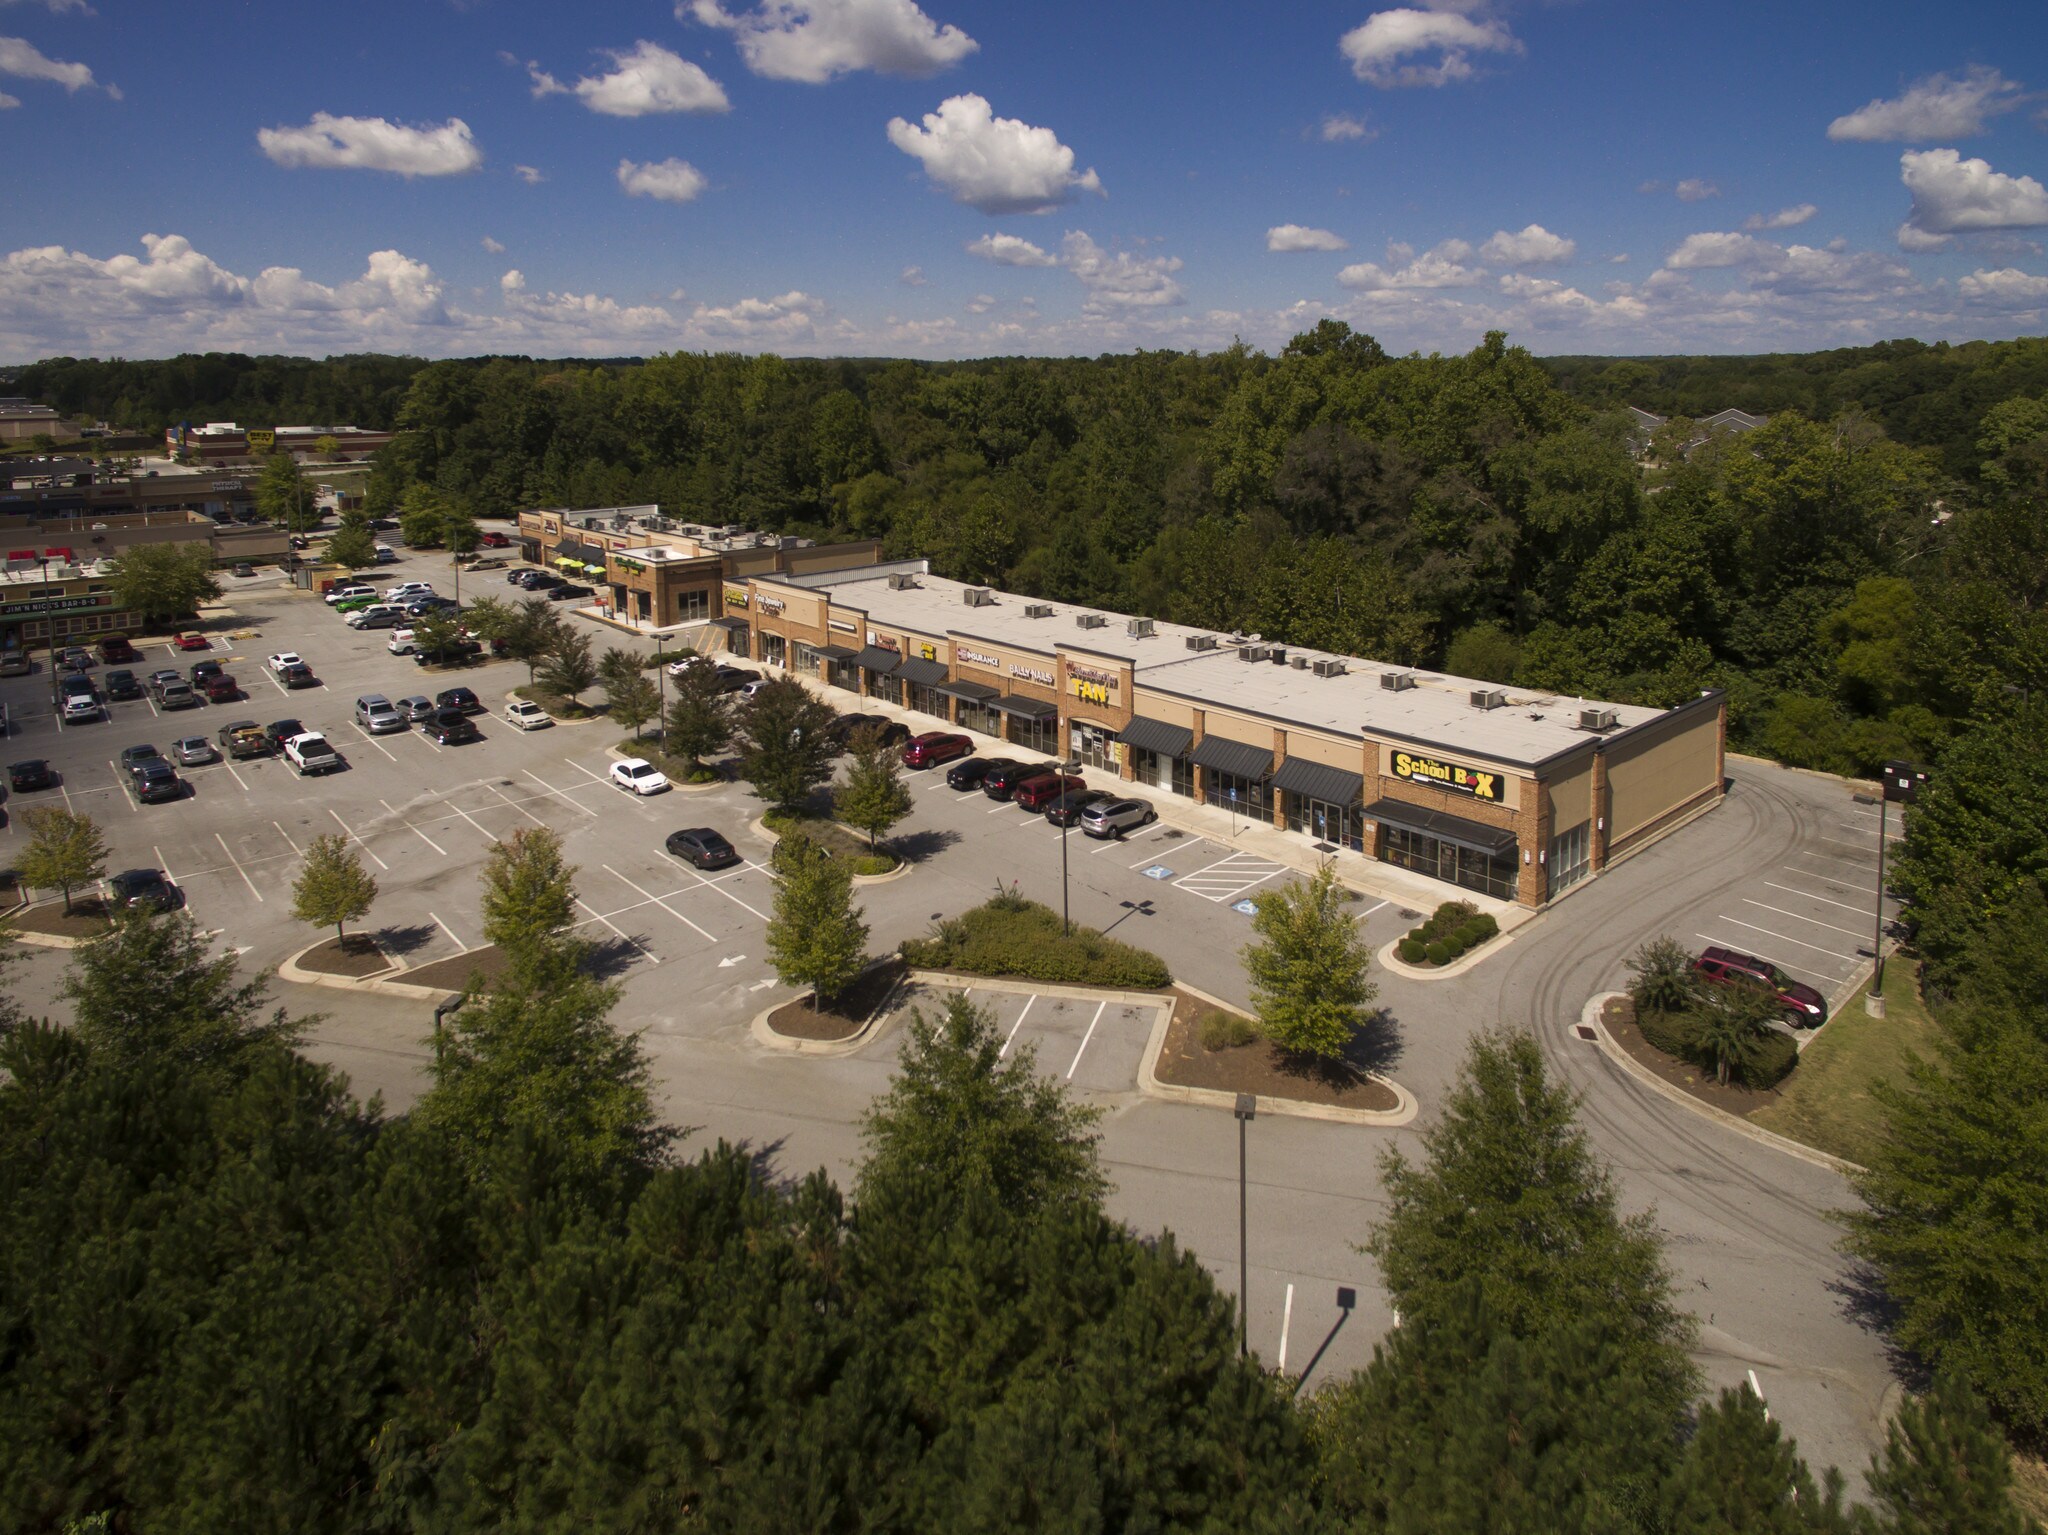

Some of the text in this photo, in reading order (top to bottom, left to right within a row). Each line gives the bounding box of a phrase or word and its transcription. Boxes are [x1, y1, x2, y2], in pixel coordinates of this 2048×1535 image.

[967, 651, 999, 666] INSURANCE
[1071, 678, 1106, 702] TAN
[1396, 753, 1450, 780] School
